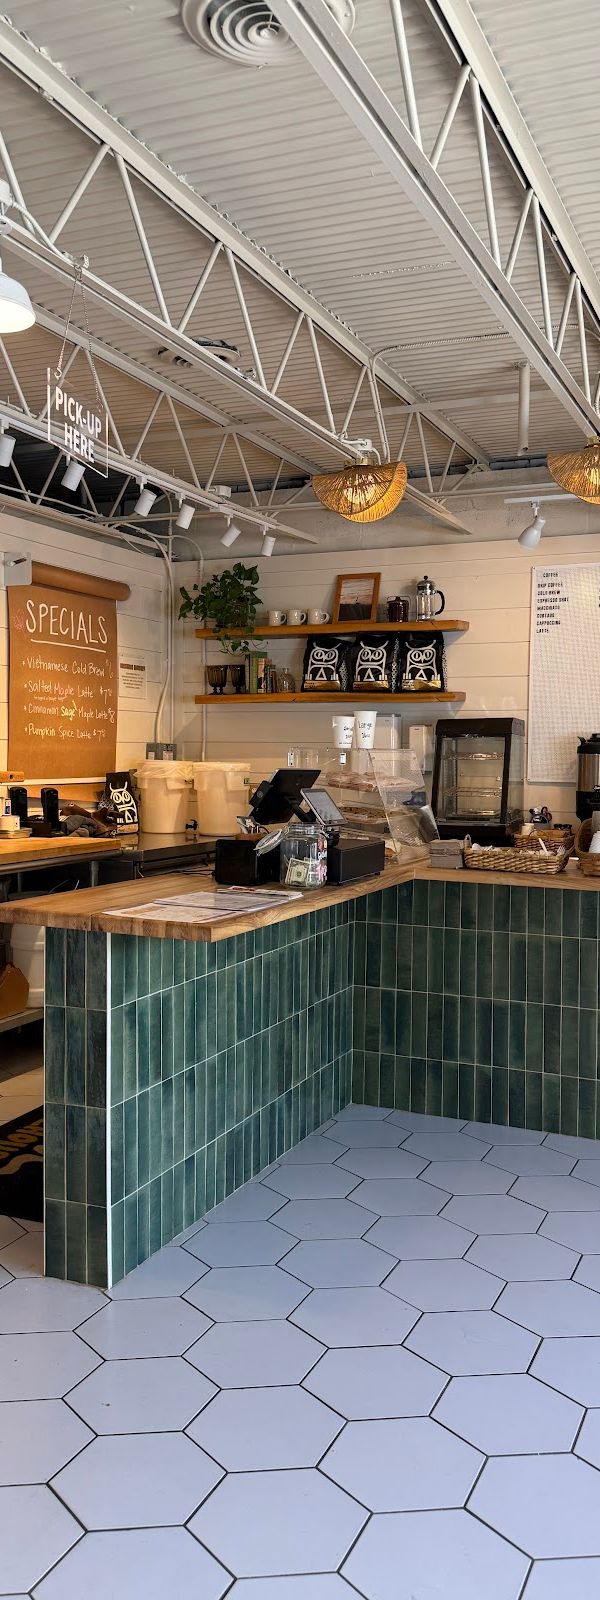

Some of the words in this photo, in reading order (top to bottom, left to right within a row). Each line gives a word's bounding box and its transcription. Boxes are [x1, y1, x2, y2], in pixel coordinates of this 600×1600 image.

[55, 386, 102, 438] PICK-UP
[64, 422, 95, 463] HERE
[26, 600, 108, 644] SPECIALS
[26, 655, 68, 673] Vietnamese
[72, 660, 87, 675] Cold
[88, 662, 105, 678] Brew
[28, 679, 53, 694] Salted
[28, 722, 56, 740] Pumpkin
[58, 726, 74, 740] Spice
